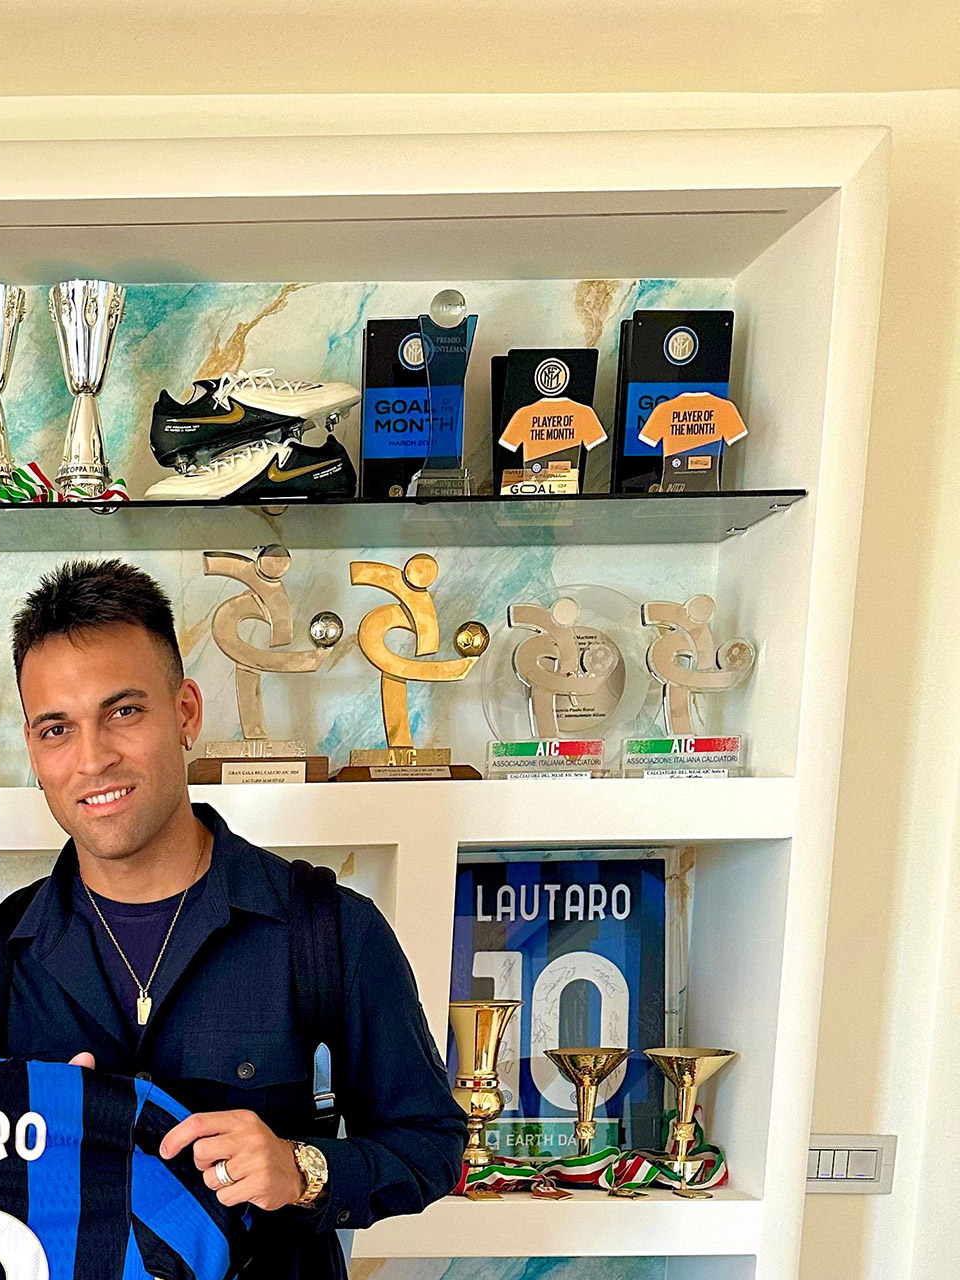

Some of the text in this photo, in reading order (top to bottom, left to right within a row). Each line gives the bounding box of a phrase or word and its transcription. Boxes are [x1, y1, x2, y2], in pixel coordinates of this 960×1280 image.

[375, 399, 436, 414] GOAL
[532, 415, 575, 428] PLAYER OF
[672, 409, 715, 423] PLAYER OF
[375, 417, 454, 434] MONTH
[670, 423, 715, 435] THE MONTH
[530, 428, 575, 440] THE MONTH
[510, 484, 555, 495] GOAL
[536, 741, 560, 757] AIC
[671, 738, 696, 754] AIC
[387, 750, 417, 766] AIC
[626, 757, 673, 765] ASSOCIAZIONE
[477, 884, 632, 922] LAUTARO
[472, 951, 630, 1111] 10
[506, 1133, 577, 1147] EARTH DA
